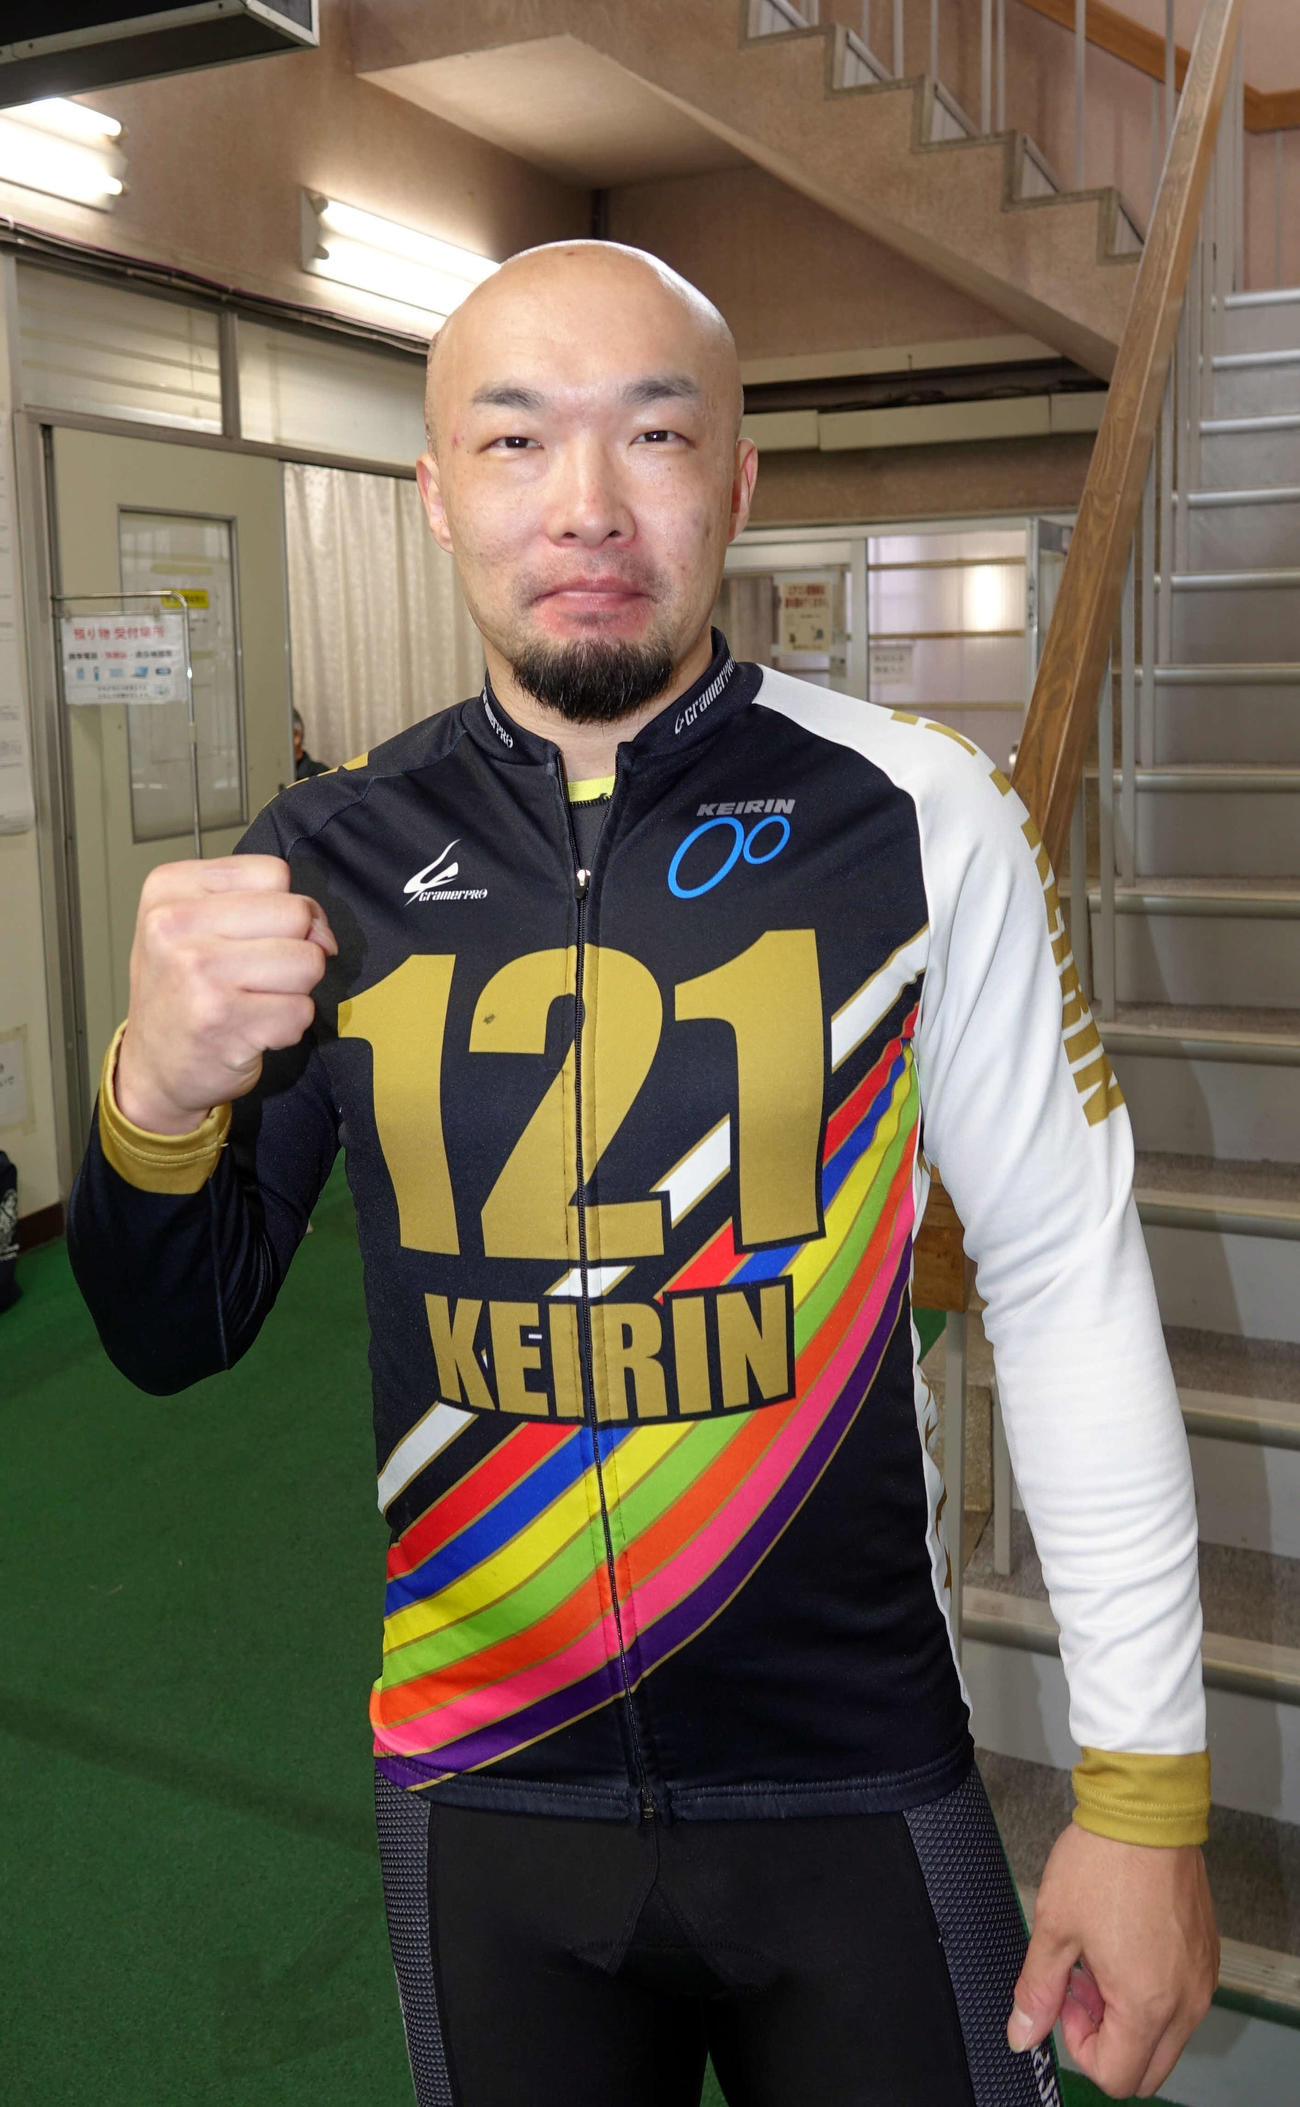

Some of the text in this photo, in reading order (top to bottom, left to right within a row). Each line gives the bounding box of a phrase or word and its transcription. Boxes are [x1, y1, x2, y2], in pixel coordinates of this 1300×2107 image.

[697, 799, 795, 817] KEIRIN
[337, 928, 825, 1260] 121
[424, 1284, 790, 1420] KEIRIN
